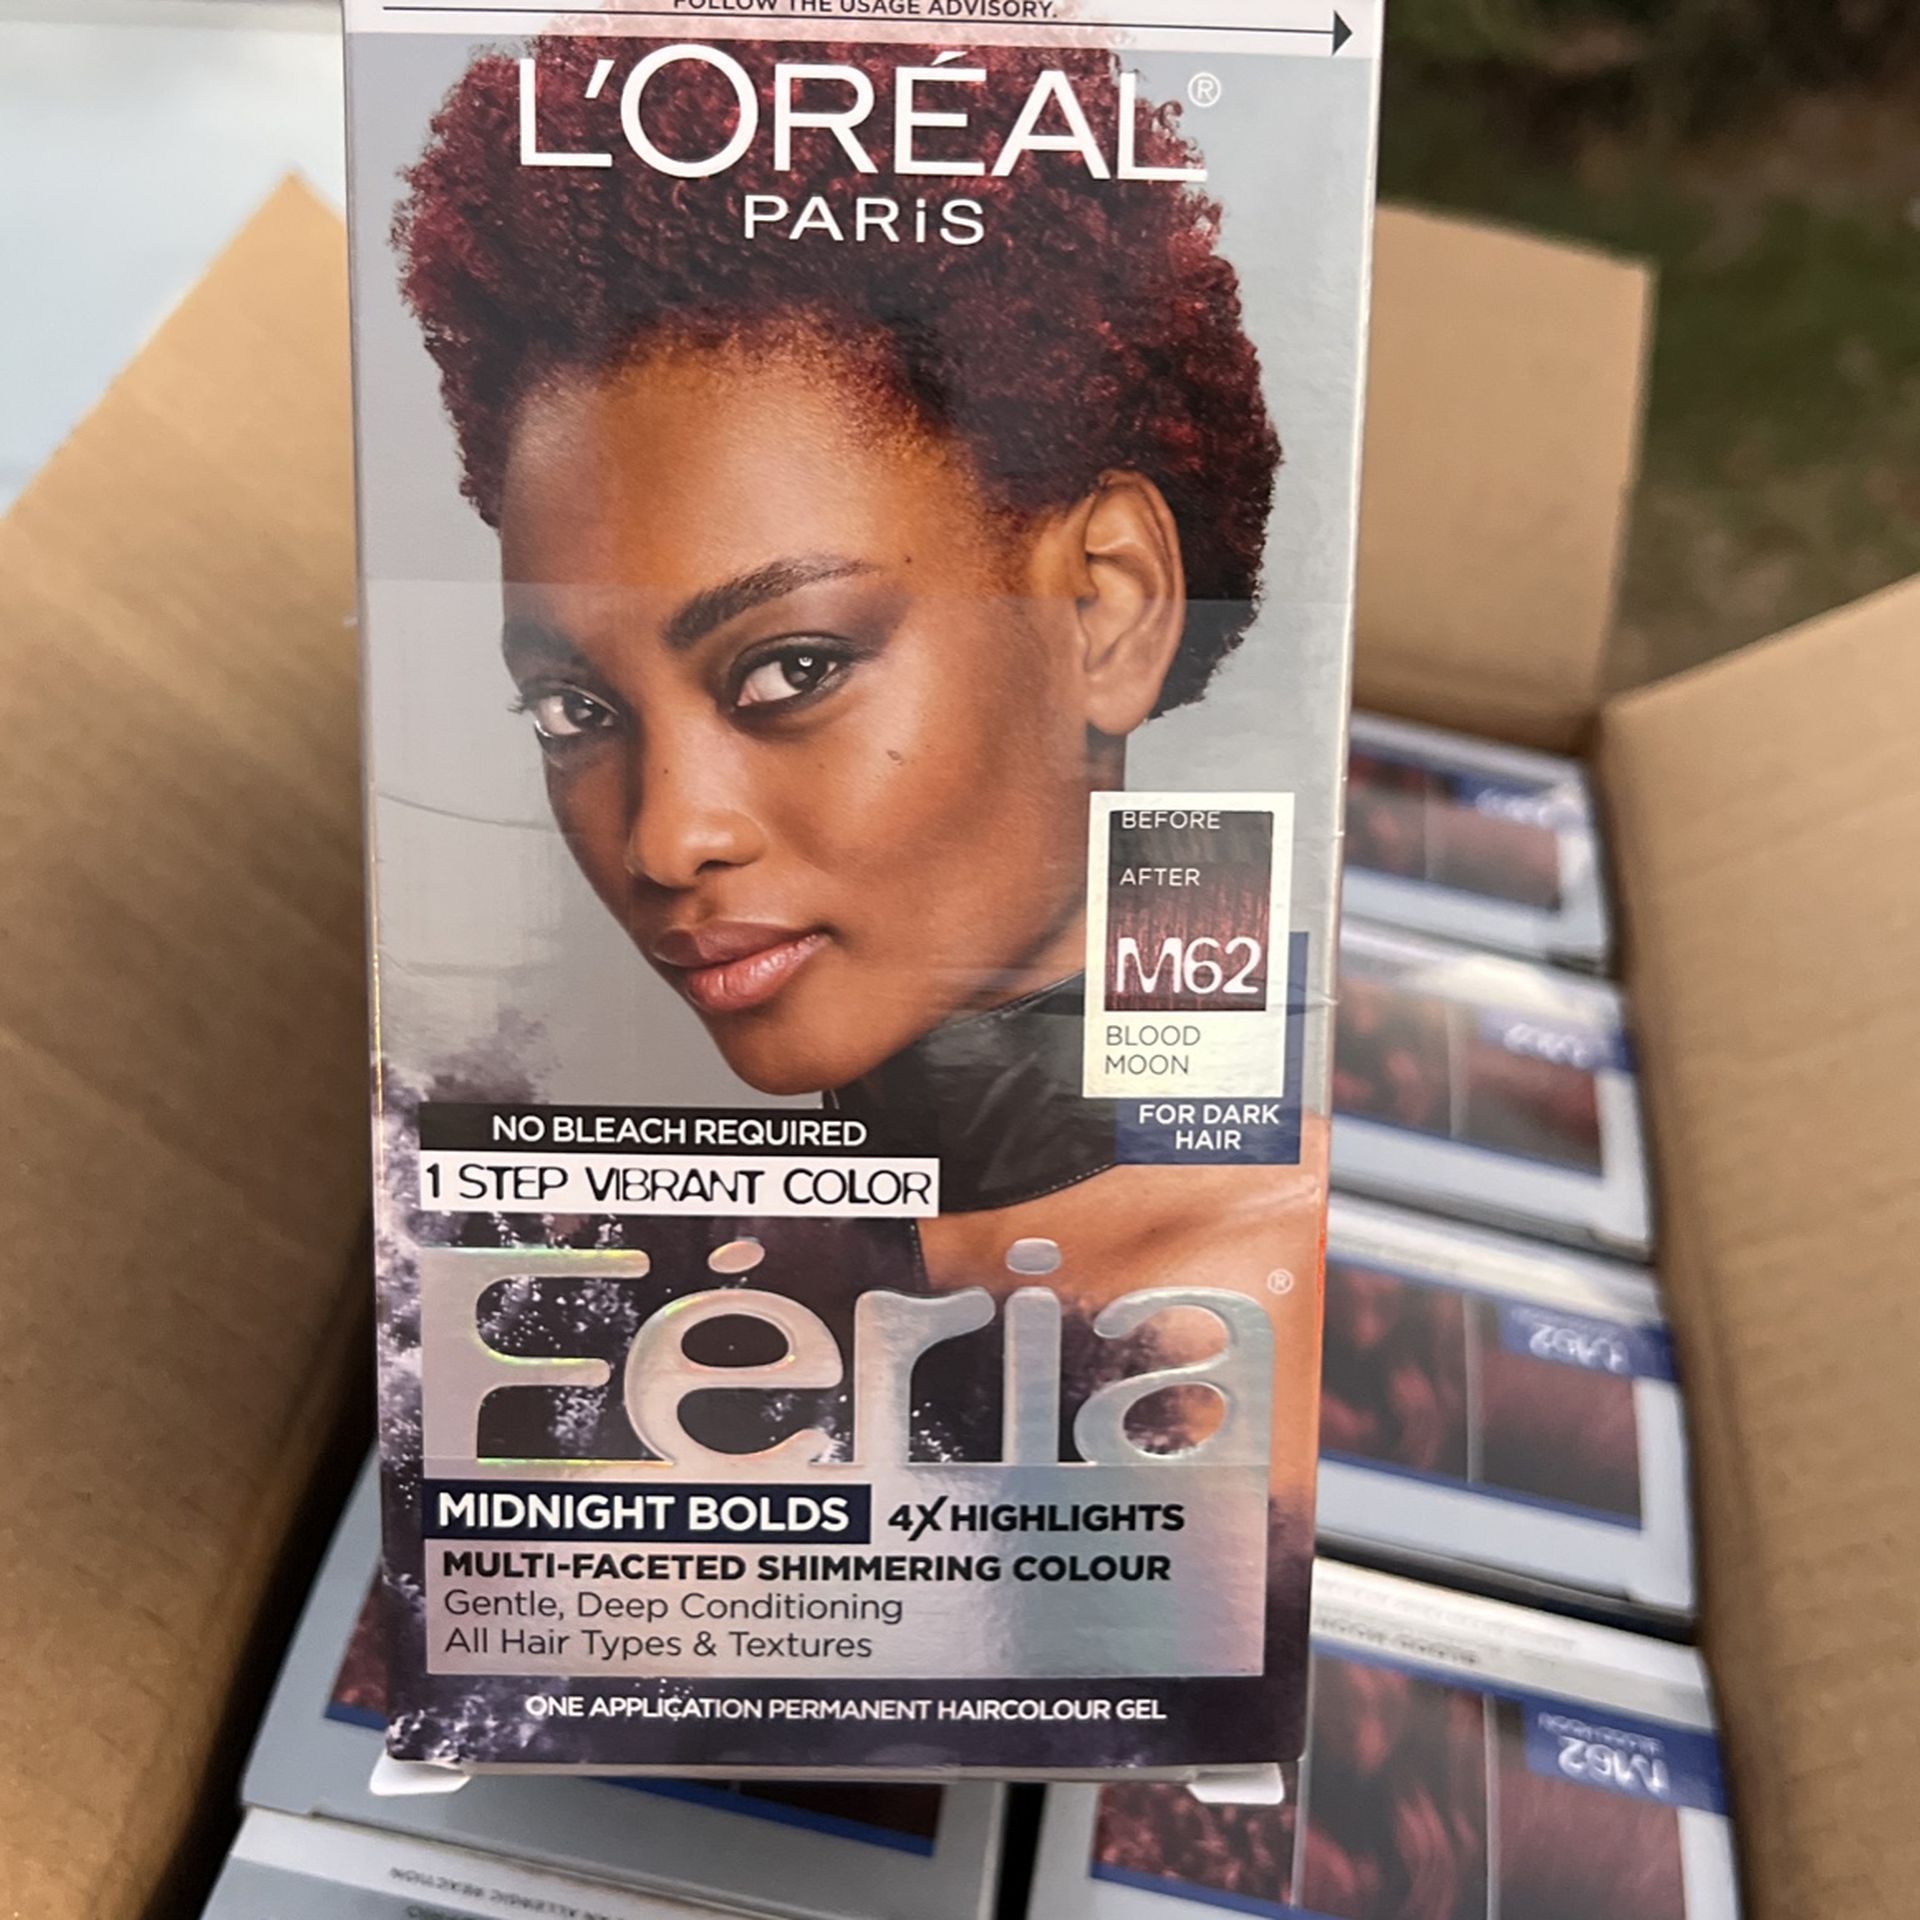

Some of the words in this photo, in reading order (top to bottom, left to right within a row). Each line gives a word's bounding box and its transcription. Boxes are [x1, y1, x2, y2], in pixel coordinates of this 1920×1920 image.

[673, 0, 776, 11] FOLLOW
[787, 0, 832, 13] THE
[840, 0, 921, 14] USAGE
[927, 0, 1058, 18] ADVISORY.
[519, 44, 1207, 182] L'ORÉAL
[1121, 810, 1222, 830] BEFORE
[1119, 867, 1201, 887] AFTER
[1116, 936, 1262, 995] M62
[1105, 1025, 1201, 1047] BLOOD
[1104, 1053, 1189, 1076] MOON
[1138, 1104, 1196, 1125] FOR
[1203, 1104, 1280, 1126] DARK
[492, 1115, 545, 1143] NO
[553, 1116, 687, 1145] BLEACH
[694, 1118, 868, 1147] REQUIRED
[1174, 1129, 1242, 1151] HAIR
[425, 1164, 441, 1198] 1
[458, 1163, 569, 1201] STEP
[585, 1166, 765, 1204] VIBRANT
[783, 1168, 932, 1206] COLOR
[421, 1238, 1276, 1466] Féria
[437, 1491, 676, 1531] MIDNIGHT
[688, 1496, 850, 1532] BOLDS
[951, 1503, 1186, 1533] HIGHLIGHTS
[443, 1551, 746, 1581] MULTI-FACETED
[757, 1554, 1001, 1582] SHIMMERING
[1012, 1555, 1172, 1582] COLOUR
[444, 1588, 565, 1622] Gentle,
[577, 1590, 669, 1624] Deep
[681, 1592, 903, 1625] Conditioning
[444, 1627, 489, 1653] All
[501, 1628, 570, 1655] Hair
[581, 1629, 682, 1661] Types
[692, 1630, 717, 1657] &
[729, 1630, 873, 1658] Textures
[525, 1694, 584, 1718] ONE
[589, 1695, 764, 1720] APPLICATION
[769, 1698, 932, 1721] PERMANENT
[938, 1699, 1111, 1721] HAIRCOLOUR
[1115, 1699, 1167, 1720] GEL
